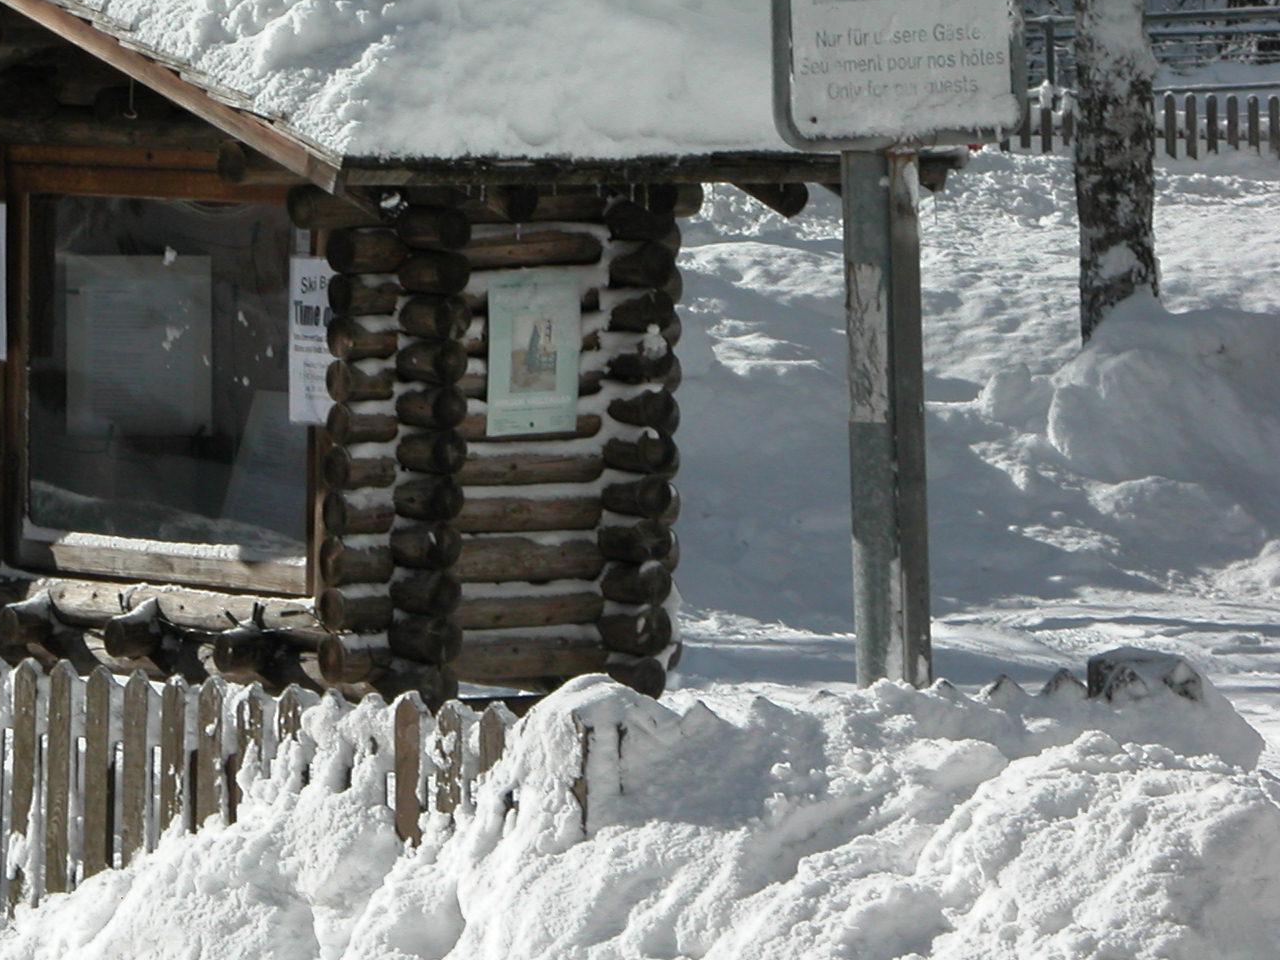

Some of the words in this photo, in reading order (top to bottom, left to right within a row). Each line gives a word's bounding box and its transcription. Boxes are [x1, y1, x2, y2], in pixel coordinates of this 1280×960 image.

[815, 30, 842, 48] Nur
[847, 27, 869, 47] für
[873, 28, 928, 45] usere
[886, 54, 923, 74] pour
[927, 53, 956, 68] nos
[960, 47, 1005, 67] hôtes
[301, 276, 317, 294] Ski
